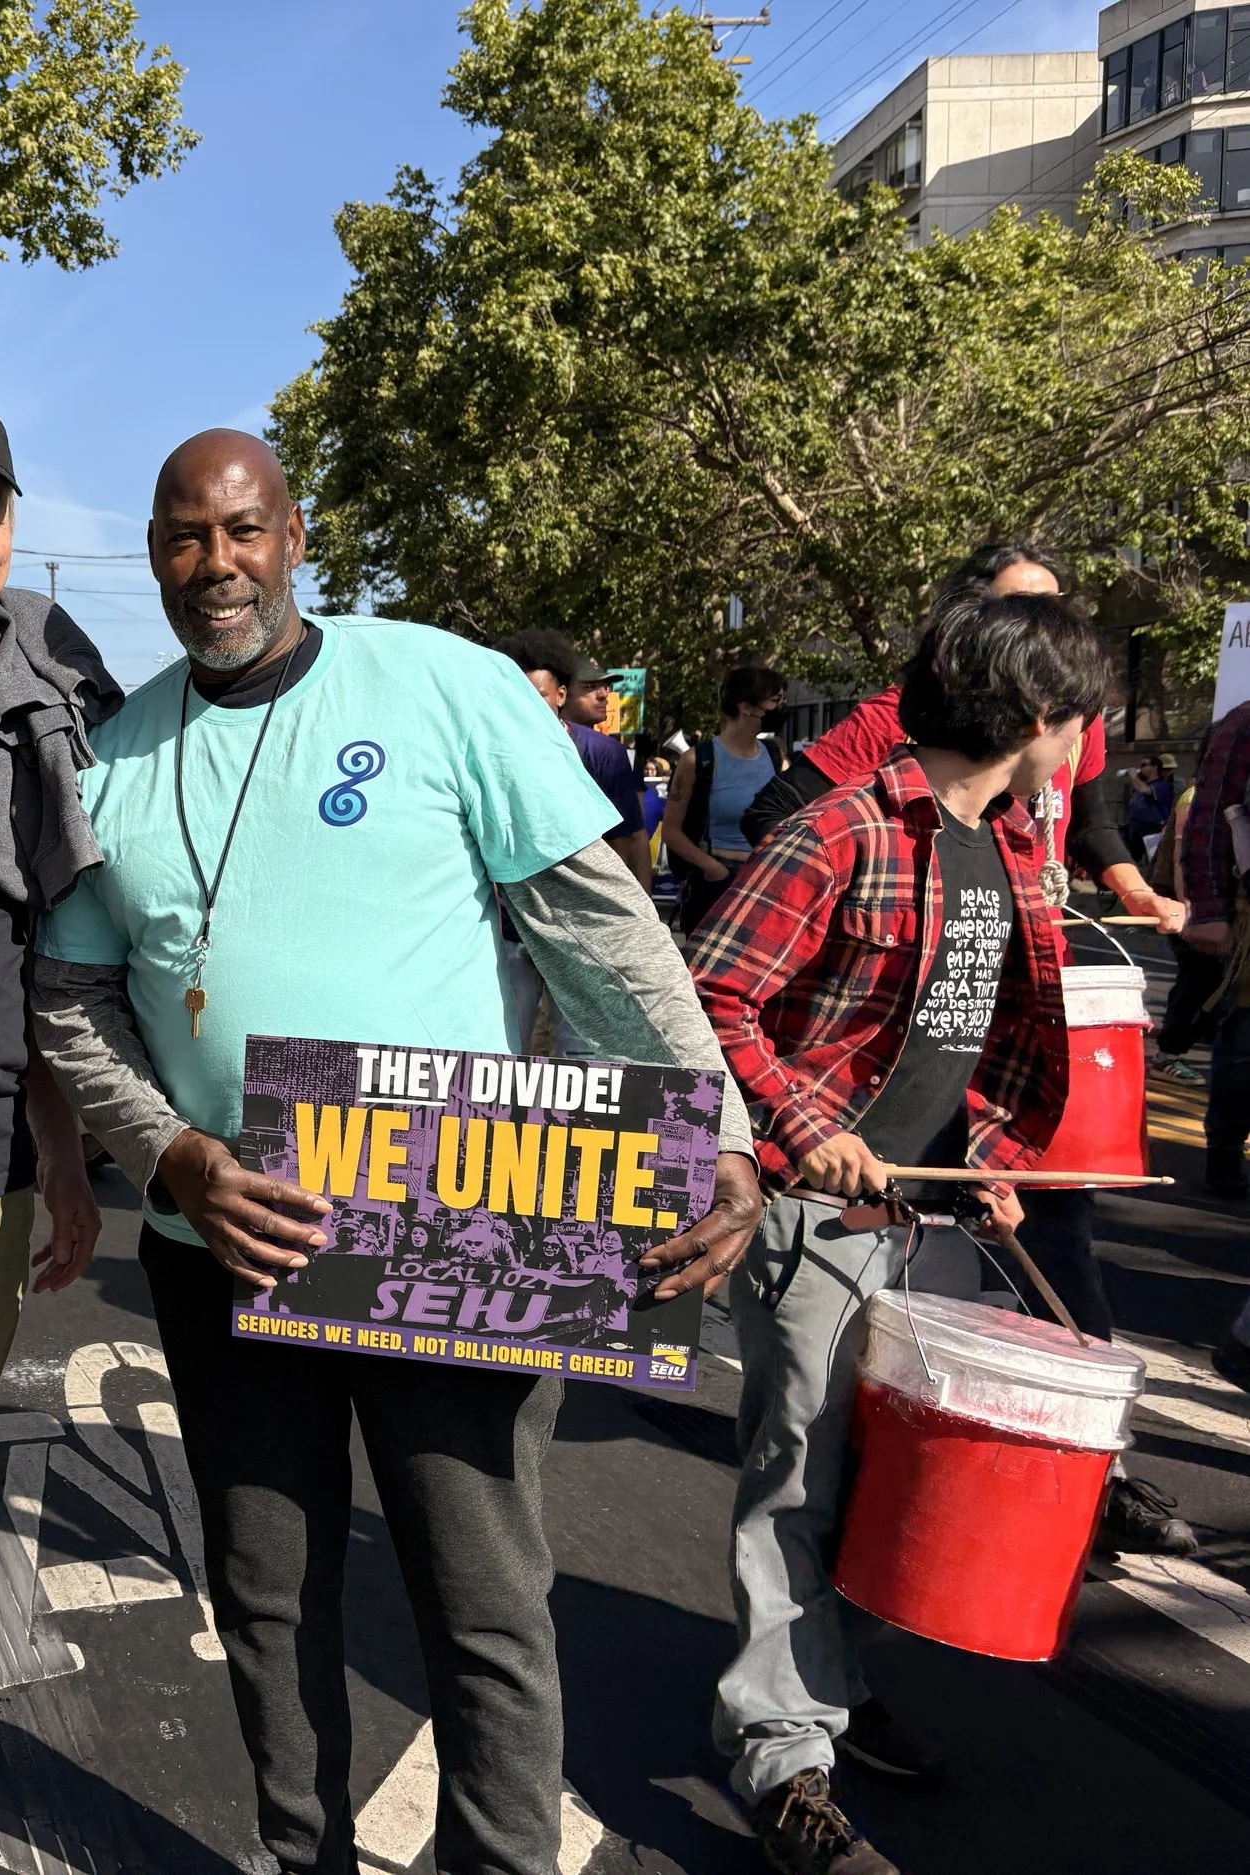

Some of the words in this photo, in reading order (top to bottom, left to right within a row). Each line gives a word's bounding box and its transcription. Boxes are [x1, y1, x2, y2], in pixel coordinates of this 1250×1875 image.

[960, 908, 977, 918] NOT
[981, 907, 999, 918] WAR
[948, 969, 970, 979] NOT
[925, 999, 946, 1008] NOT
[927, 1028, 954, 1038] NOT
[973, 1027, 986, 1037] US
[357, 1049, 459, 1099] THEY
[470, 1058, 622, 1115] DIVIDE!
[295, 1102, 411, 1204] WE
[436, 1115, 678, 1230] UNITE.
[384, 1261, 482, 1283] LOCAL
[370, 1280, 552, 1333] SEIU
[237, 1312, 321, 1342] SERVICES
[324, 1324, 354, 1347] WE
[357, 1328, 408, 1355] NEED,
[413, 1336, 449, 1358] NOT
[453, 1340, 564, 1371] BILLIONAIRE
[569, 1354, 634, 1379] GREED!
[649, 1364, 686, 1376] SEIU
